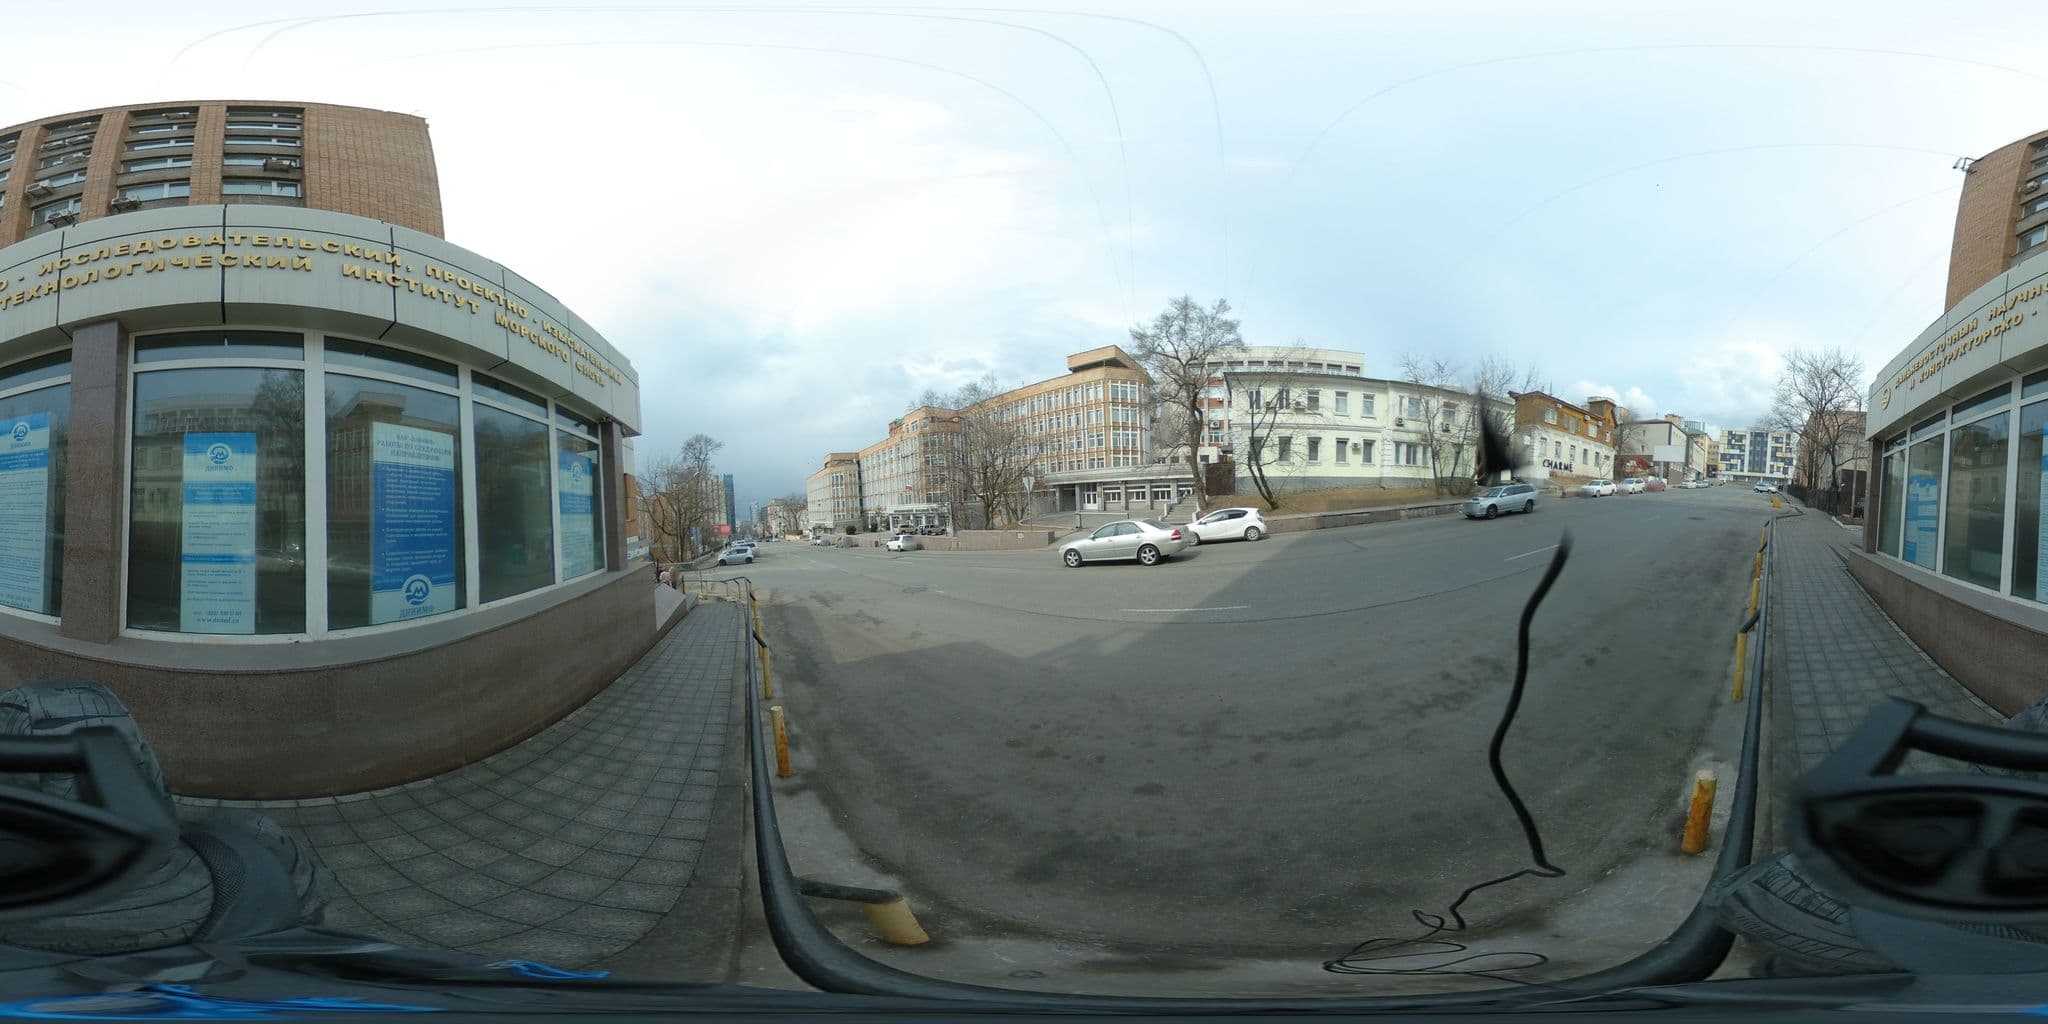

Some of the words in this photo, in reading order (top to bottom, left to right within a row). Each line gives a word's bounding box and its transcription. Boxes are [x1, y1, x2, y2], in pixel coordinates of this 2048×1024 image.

[343, 263, 478, 314] ИНСТИТУТ
[495, 312, 569, 363] МОРСКОГО
[425, 264, 528, 318] ПРОЕКТНО
[1919, 313, 2023, 383] КОНСТРУКТОРСКО
[1543, 459, 1573, 473] CHARME
